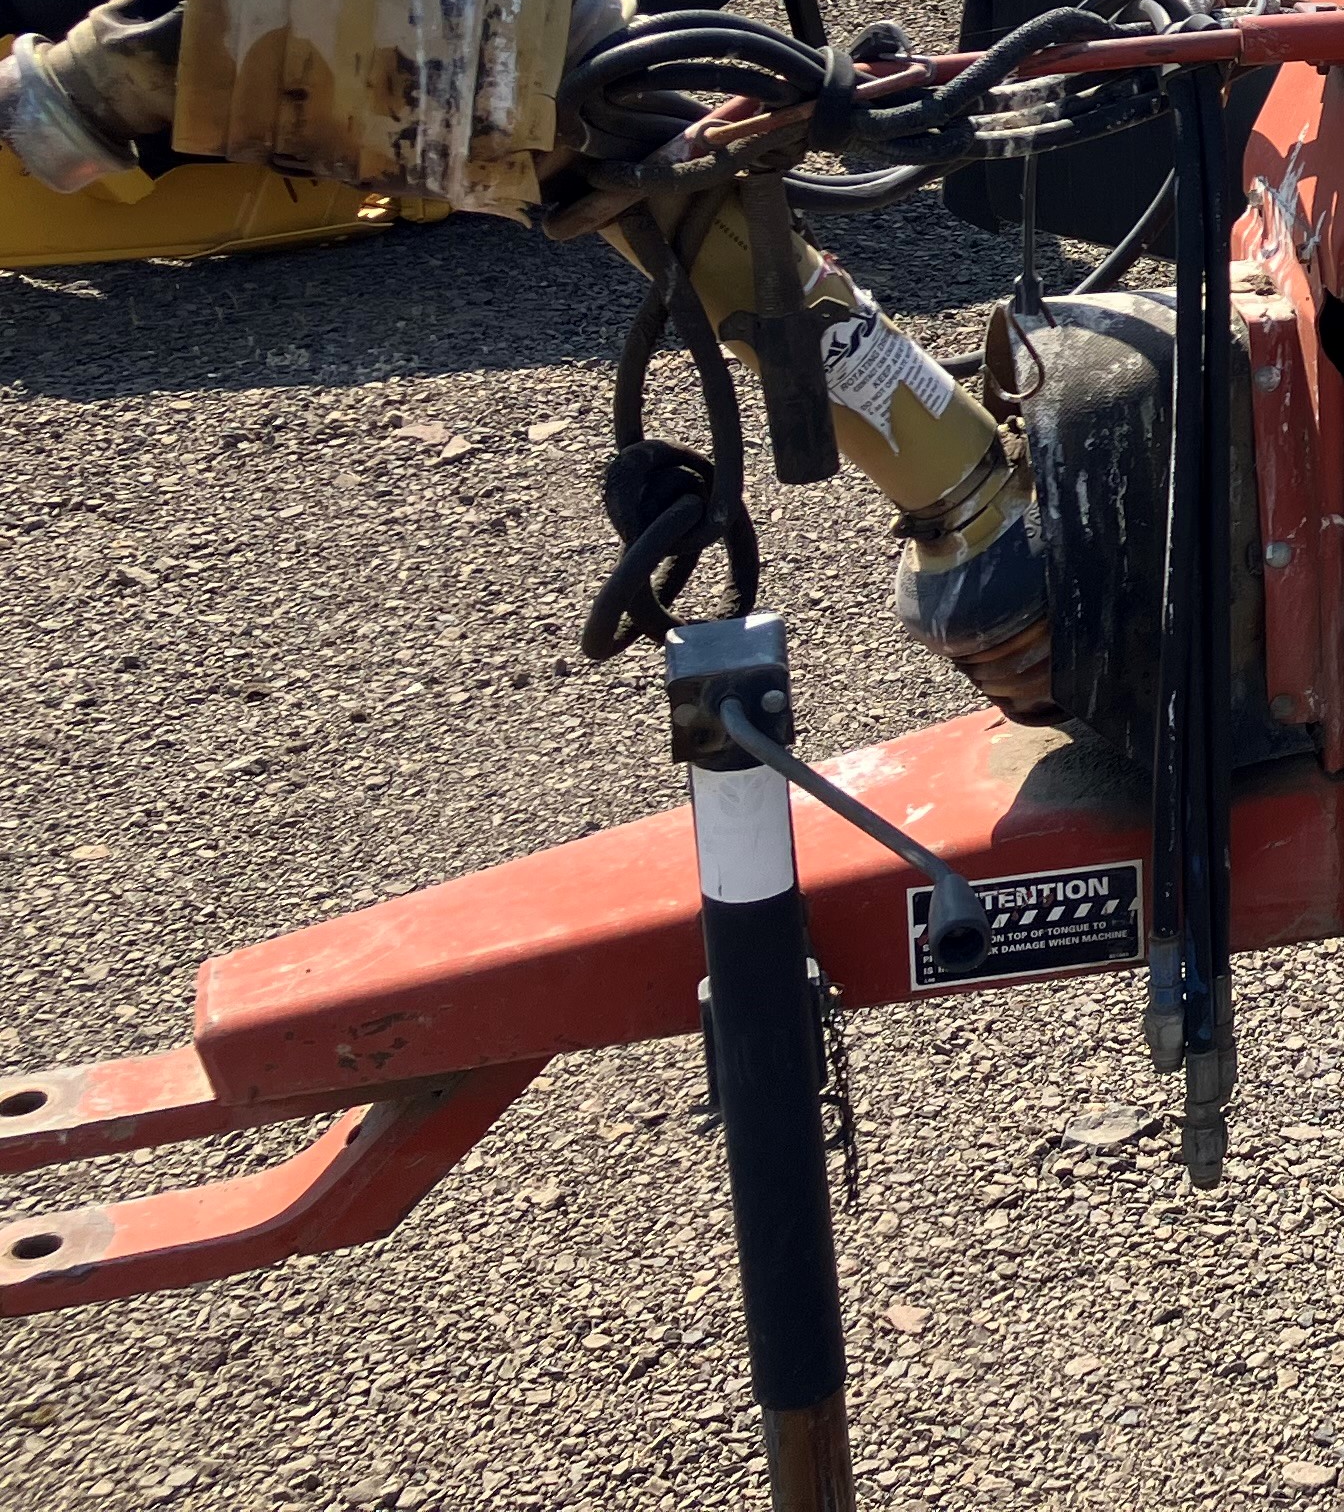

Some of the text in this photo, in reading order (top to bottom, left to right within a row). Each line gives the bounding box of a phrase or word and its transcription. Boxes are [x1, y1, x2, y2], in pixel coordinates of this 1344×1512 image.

[977, 876, 1109, 910] TENTION
[1002, 941, 1046, 954] DAMAGE
[1048, 936, 1080, 947] WHEN
[1082, 930, 1128, 943] MACHINE
[1007, 930, 1028, 941] TOP
[1030, 928, 1044, 938] OF
[1047, 923, 1090, 935] TONGUE
